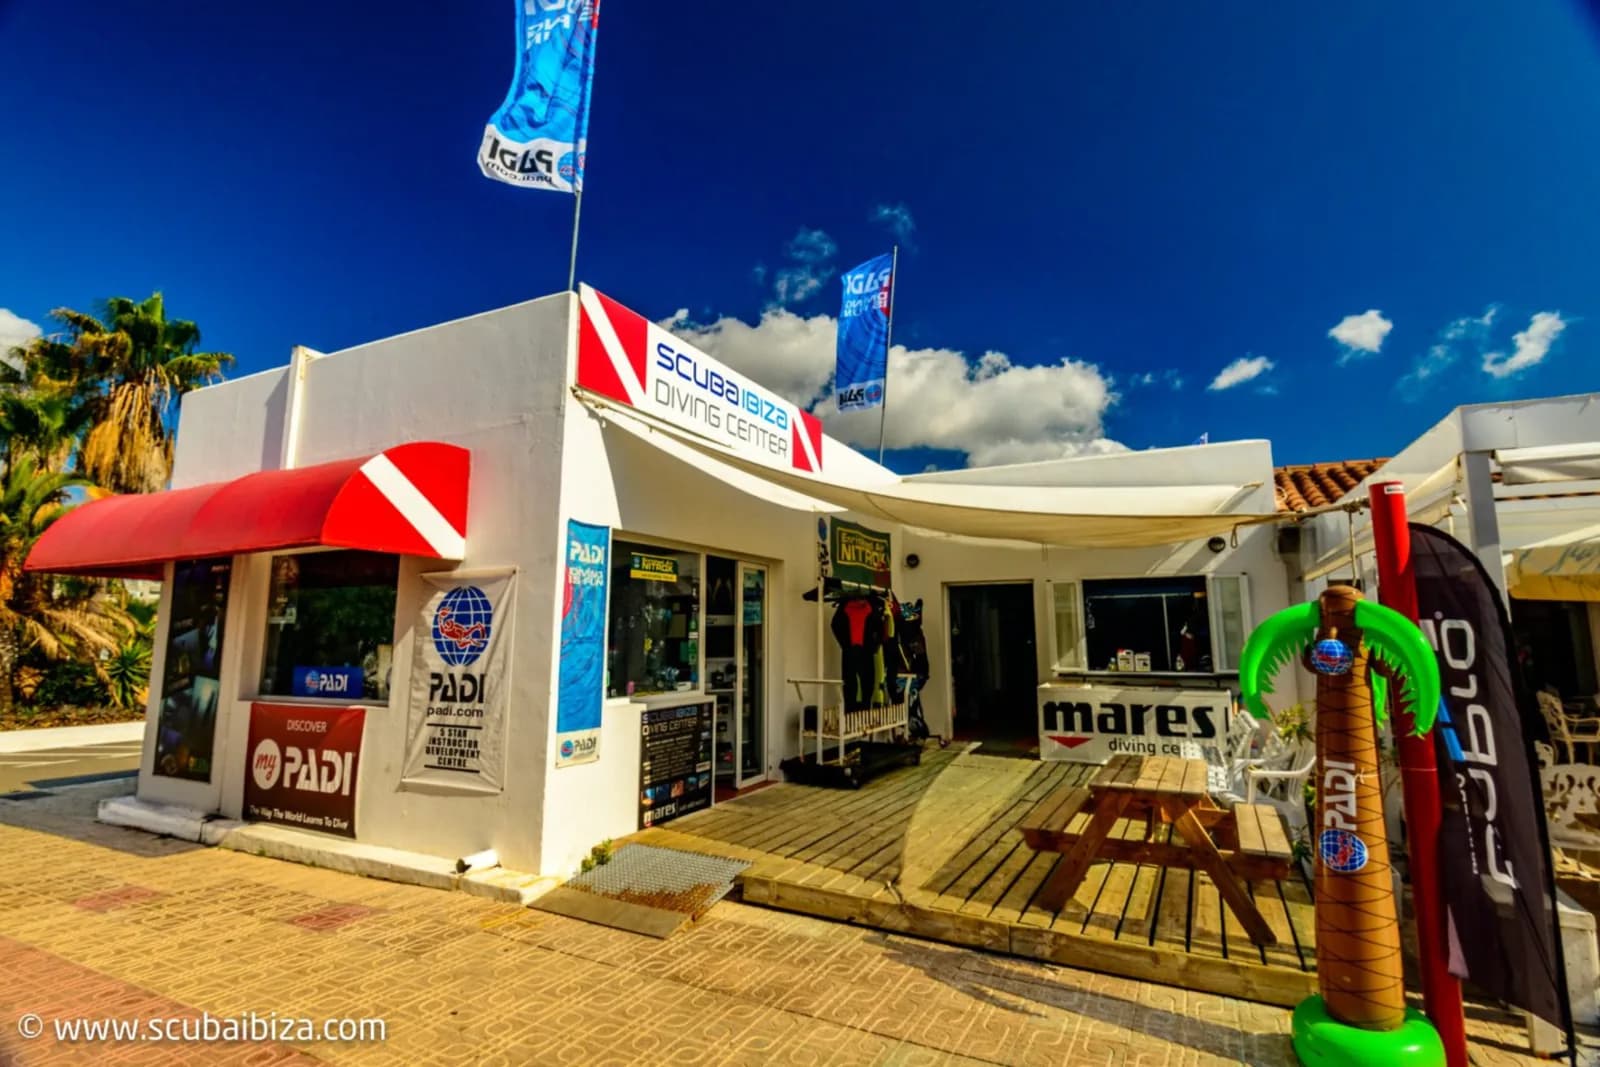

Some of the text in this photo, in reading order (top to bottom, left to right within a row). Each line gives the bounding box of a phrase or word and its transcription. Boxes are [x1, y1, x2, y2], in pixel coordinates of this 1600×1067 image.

[569, 540, 605, 565] PADI
[320, 673, 348, 692] PADI
[429, 672, 486, 704] PADI
[426, 705, 484, 717] padi.com
[1043, 701, 1216, 739] mares
[286, 719, 327, 733] DISCOVER
[440, 728, 468, 738] 5 STAR
[429, 736, 478, 749] INSTRUCTOR
[574, 736, 597, 752] PADI
[1108, 738, 1156, 756] diving
[425, 746, 481, 759] DEVELOPMENT
[255, 746, 353, 796] my PADI
[437, 756, 467, 768] CENTRE
[1323, 760, 1357, 831] PADI
[644, 803, 676, 825] mares
